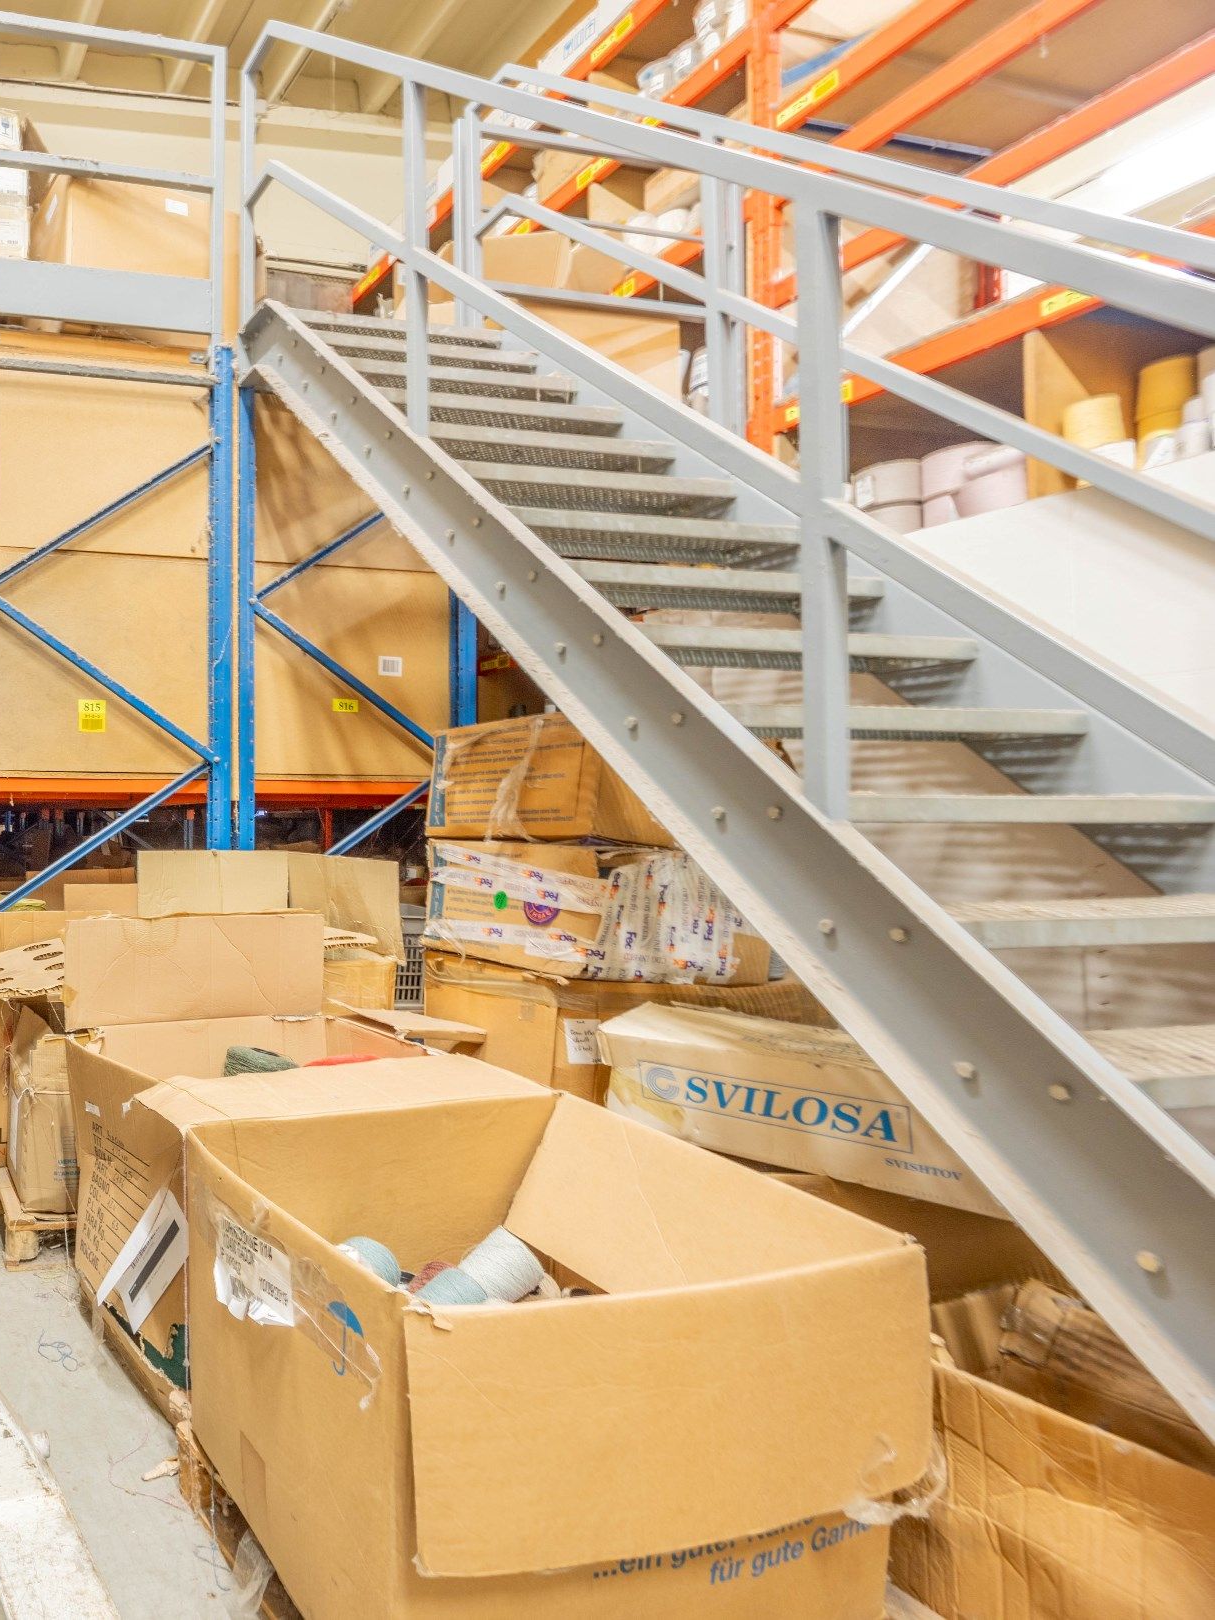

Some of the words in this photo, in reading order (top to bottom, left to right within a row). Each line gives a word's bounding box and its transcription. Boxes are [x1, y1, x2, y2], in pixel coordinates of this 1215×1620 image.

[84, 702, 101, 712] 815
[338, 701, 354, 711] 816
[704, 906, 717, 941] FedEx
[685, 1077, 898, 1142] SVILOSA
[885, 1157, 963, 1182] SVISHTOV
[91, 1171, 111, 1197] BAGNO.
[709, 1558, 745, 1585] für
[751, 1539, 806, 1578] gute
